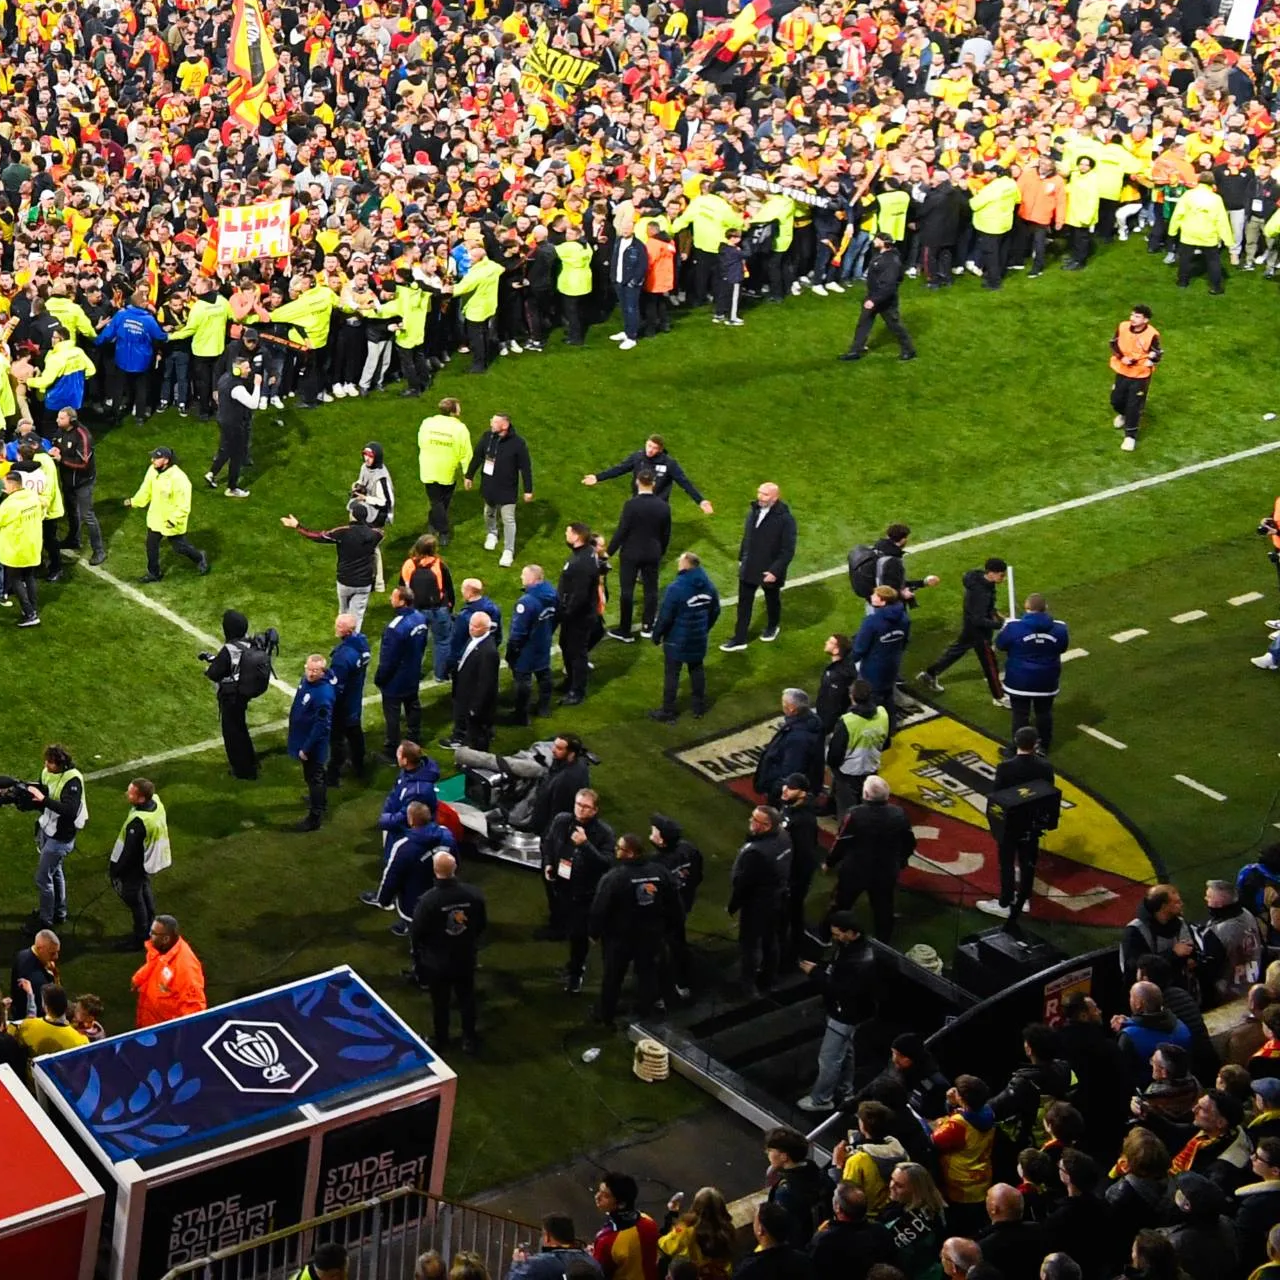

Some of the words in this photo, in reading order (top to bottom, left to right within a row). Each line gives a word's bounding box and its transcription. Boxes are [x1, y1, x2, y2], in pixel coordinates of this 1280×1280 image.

[224, 204, 281, 232] LENS
[698, 746, 768, 776] RACIN
[324, 1156, 428, 1205] BOLLAERT
[326, 1150, 395, 1186] STADE
[169, 1200, 277, 1251] BOLLAERT
[172, 1194, 242, 1232] STADE
